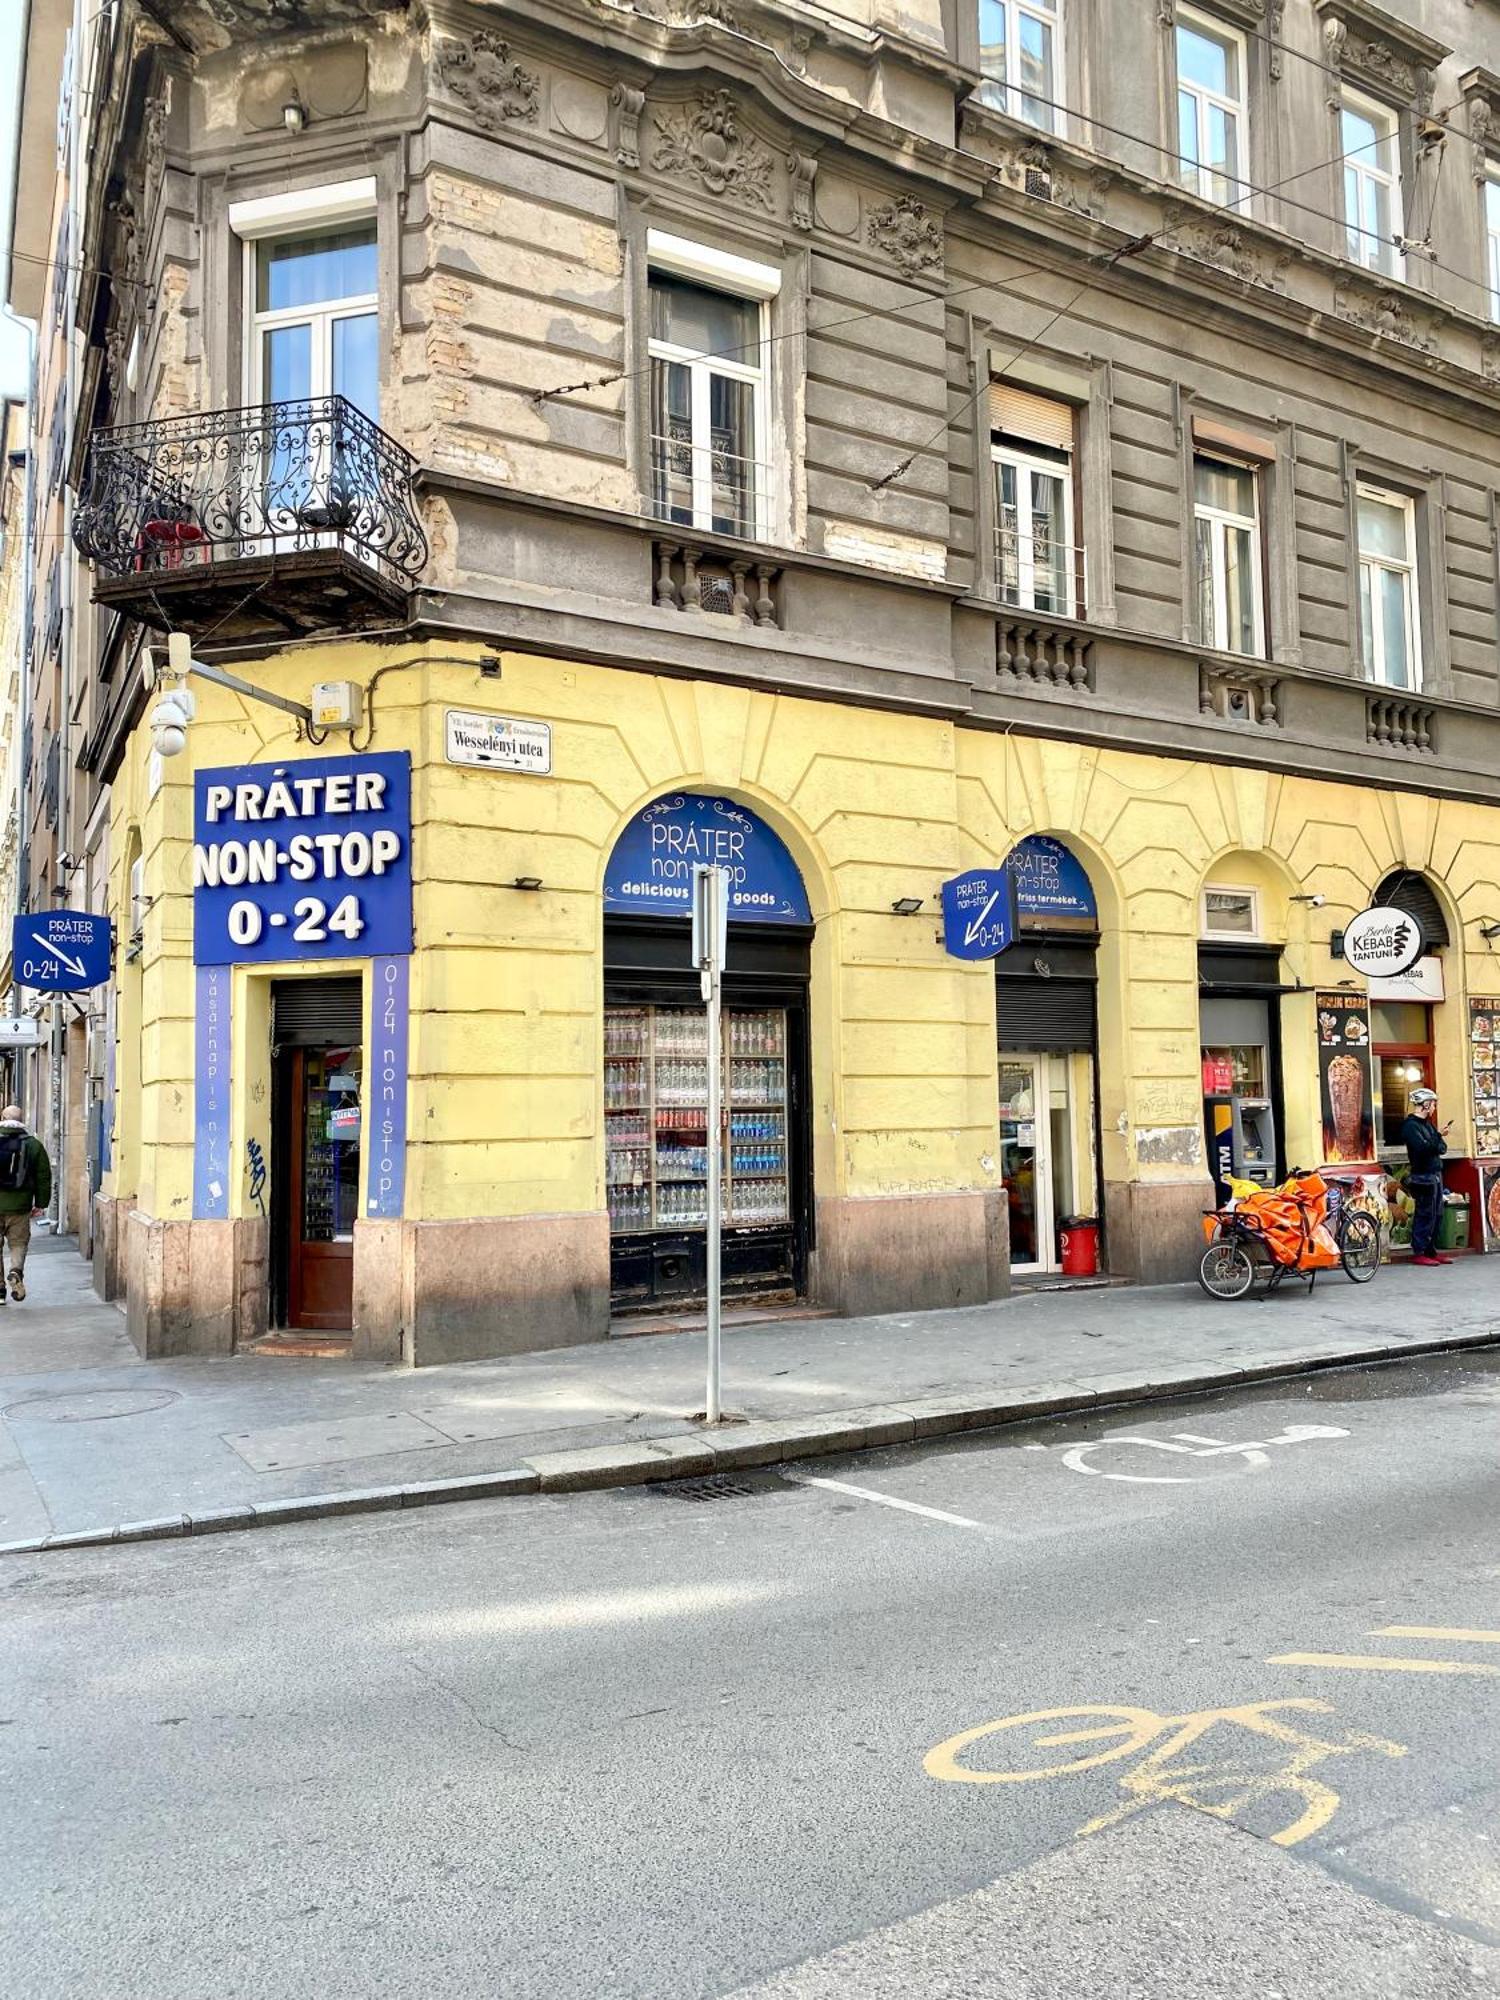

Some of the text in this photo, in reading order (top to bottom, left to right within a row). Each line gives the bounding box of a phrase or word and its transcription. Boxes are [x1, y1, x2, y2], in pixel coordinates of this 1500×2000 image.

[454, 730, 544, 758] Wesselényi utca
[206, 768, 387, 822] PRÁTER
[651, 820, 745, 861] PRÁTER
[193, 830, 400, 888] NON-STOP
[1006, 849, 1059, 875] PRÁTER
[621, 881, 689, 899] delicious
[733, 891, 776, 906] goods
[957, 879, 988, 898] PRÁTER
[1017, 892, 1037, 903] friss
[958, 895, 989, 911] non-stop
[48, 918, 93, 933] PRÁTER
[980, 921, 1005, 947] 0-24
[1363, 924, 1395, 939] Berlin
[48, 933, 94, 945] non-stop
[1352, 935, 1394, 952] KEBAB
[1353, 948, 1394, 961] TANTUNI
[23, 959, 59, 979] 0-24
